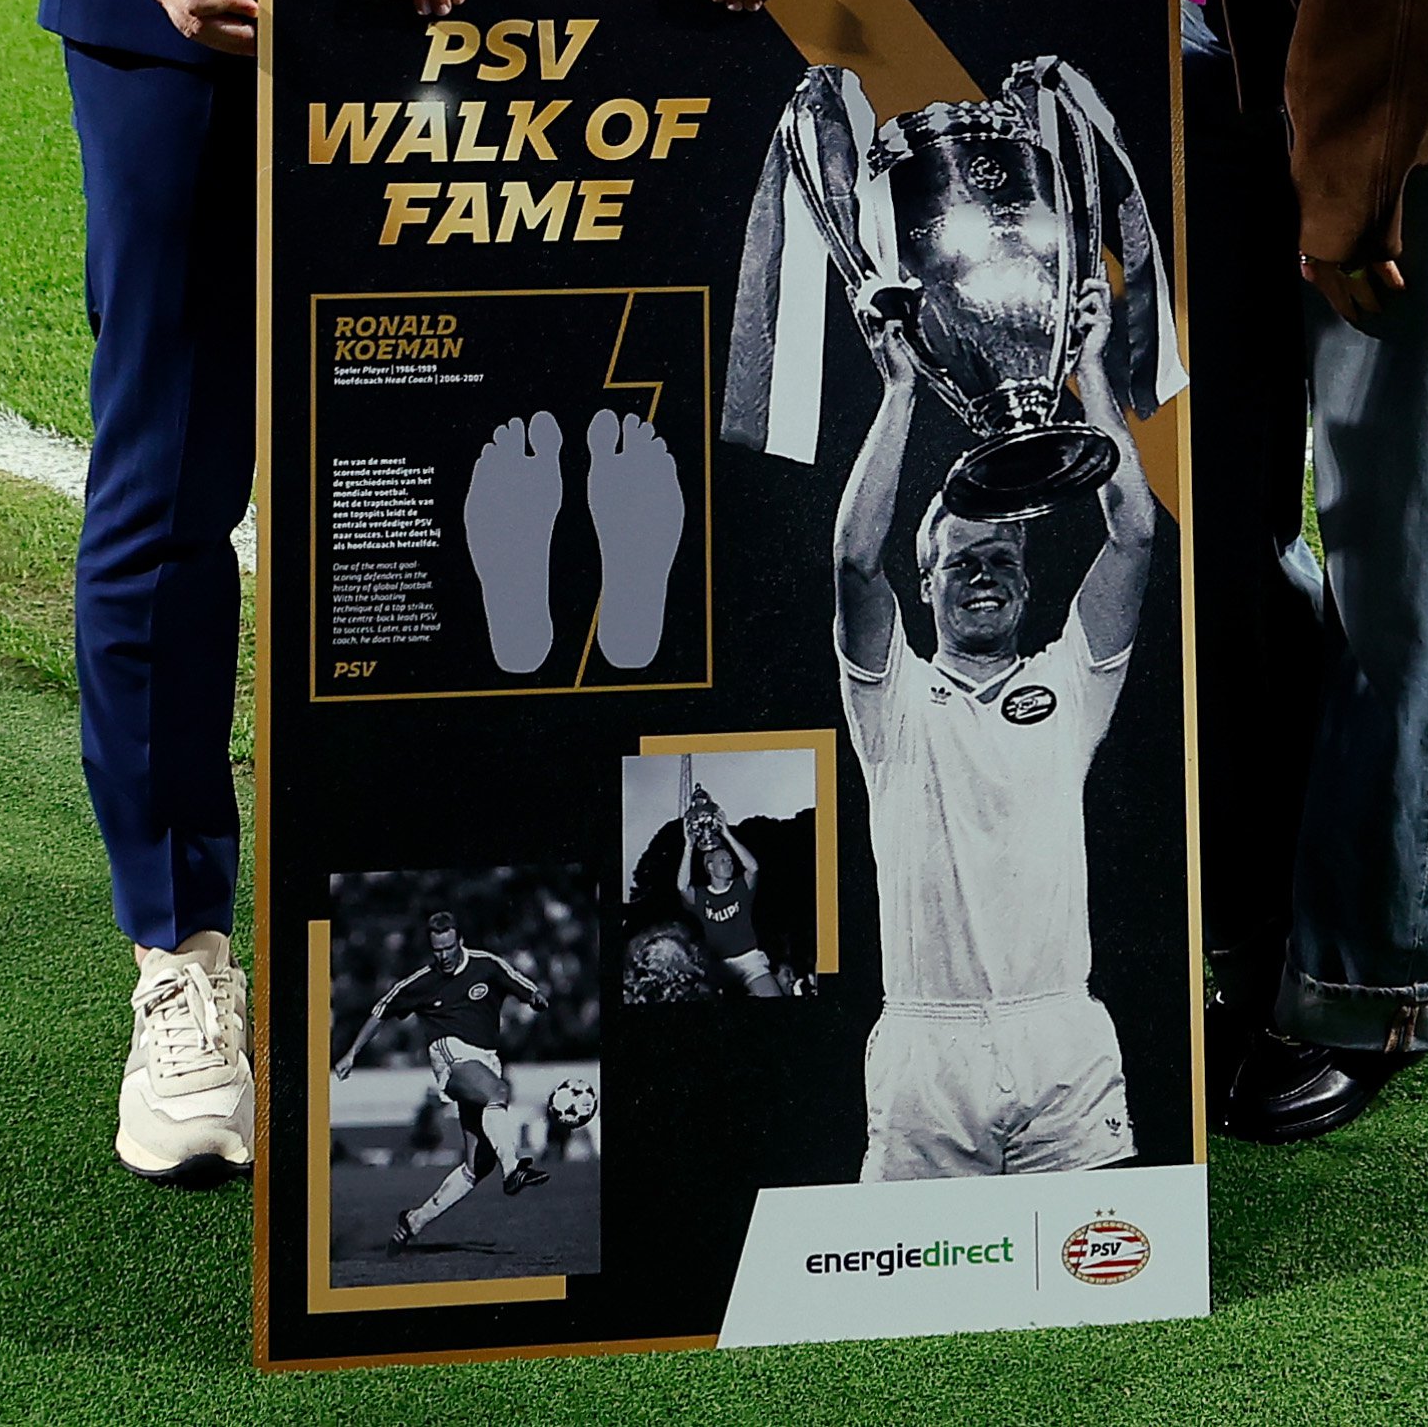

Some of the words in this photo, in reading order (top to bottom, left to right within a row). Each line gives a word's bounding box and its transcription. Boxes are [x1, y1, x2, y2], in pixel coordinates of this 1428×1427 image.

[419, 19, 599, 83] PSV
[308, 99, 573, 165] WALK
[585, 97, 711, 161] OF
[378, 179, 634, 245] FAME
[334, 315, 457, 337] RONALD
[334, 337, 464, 361] KOEMAN
[334, 366, 361, 376] Speler
[362, 365, 389, 375] Player
[395, 364, 437, 373] 1986-1989
[334, 376, 384, 386] Hoofdcoach
[385, 376, 407, 384] Head
[408, 375, 433, 384] Coach
[439, 374, 484, 383] 2006-2007
[334, 661, 377, 678] PSV
[806, 1237, 1013, 1276] energiedirect
[1090, 1242, 1122, 1257] PSV
